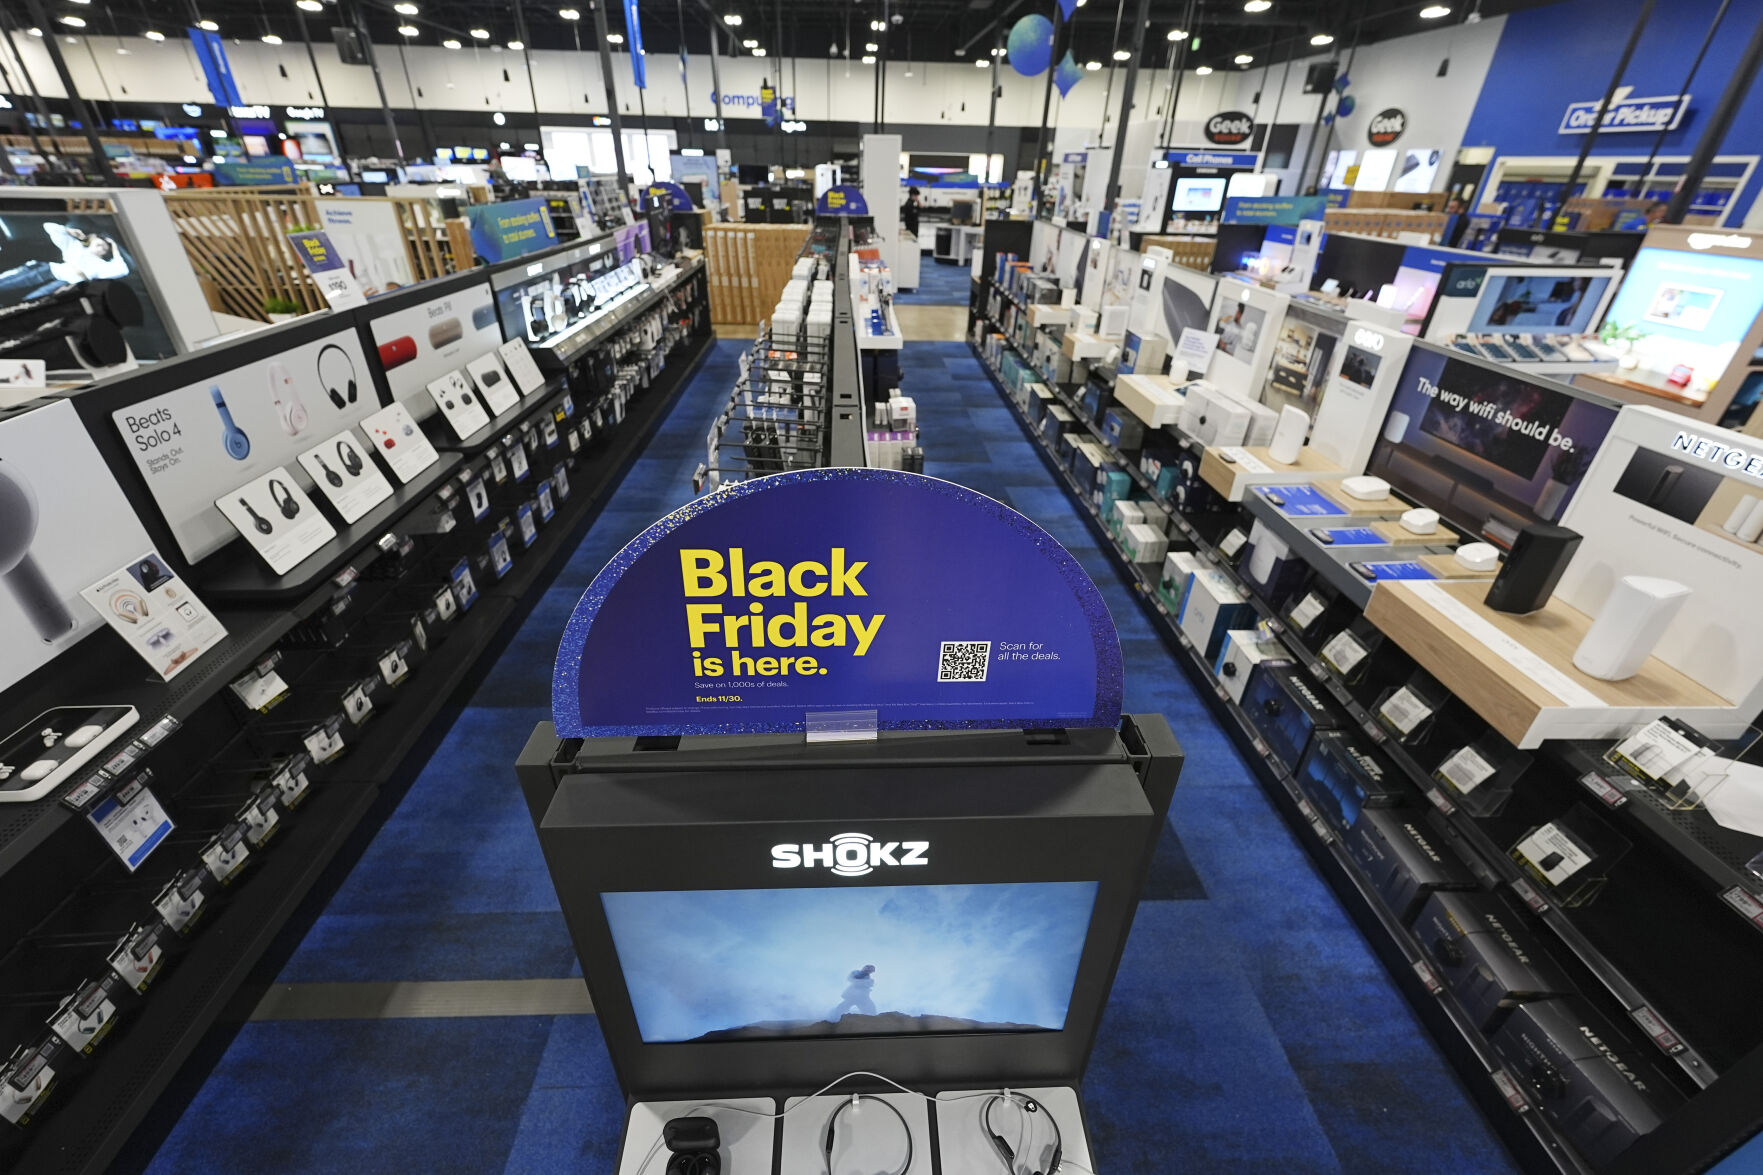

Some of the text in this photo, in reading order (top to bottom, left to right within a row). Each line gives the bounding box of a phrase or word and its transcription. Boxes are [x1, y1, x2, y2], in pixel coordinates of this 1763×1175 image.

[1209, 116, 1251, 134] Geek
[1371, 113, 1405, 136] Geek
[1613, 104, 1675, 128] Pickup
[125, 408, 172, 433] Beats
[1418, 377, 1575, 454] The way wifi should be.
[135, 421, 182, 451] Solo 4
[1671, 430, 1763, 480] NETGE
[679, 547, 869, 597] Black
[686, 602, 886, 656] Friday
[997, 651, 1061, 661] all the deals.
[1000, 641, 1044, 650] Scan for
[692, 650, 828, 677] is here.
[728, 681, 755, 689] 1,000s
[766, 680, 789, 688] deals.
[718, 695, 743, 703] 11/30.
[771, 840, 930, 870] SHOKZ
[1403, 823, 1441, 863] NETGEAR
[1485, 914, 1530, 964] NETGEAR
[1579, 1025, 1647, 1092] NETGEAR
